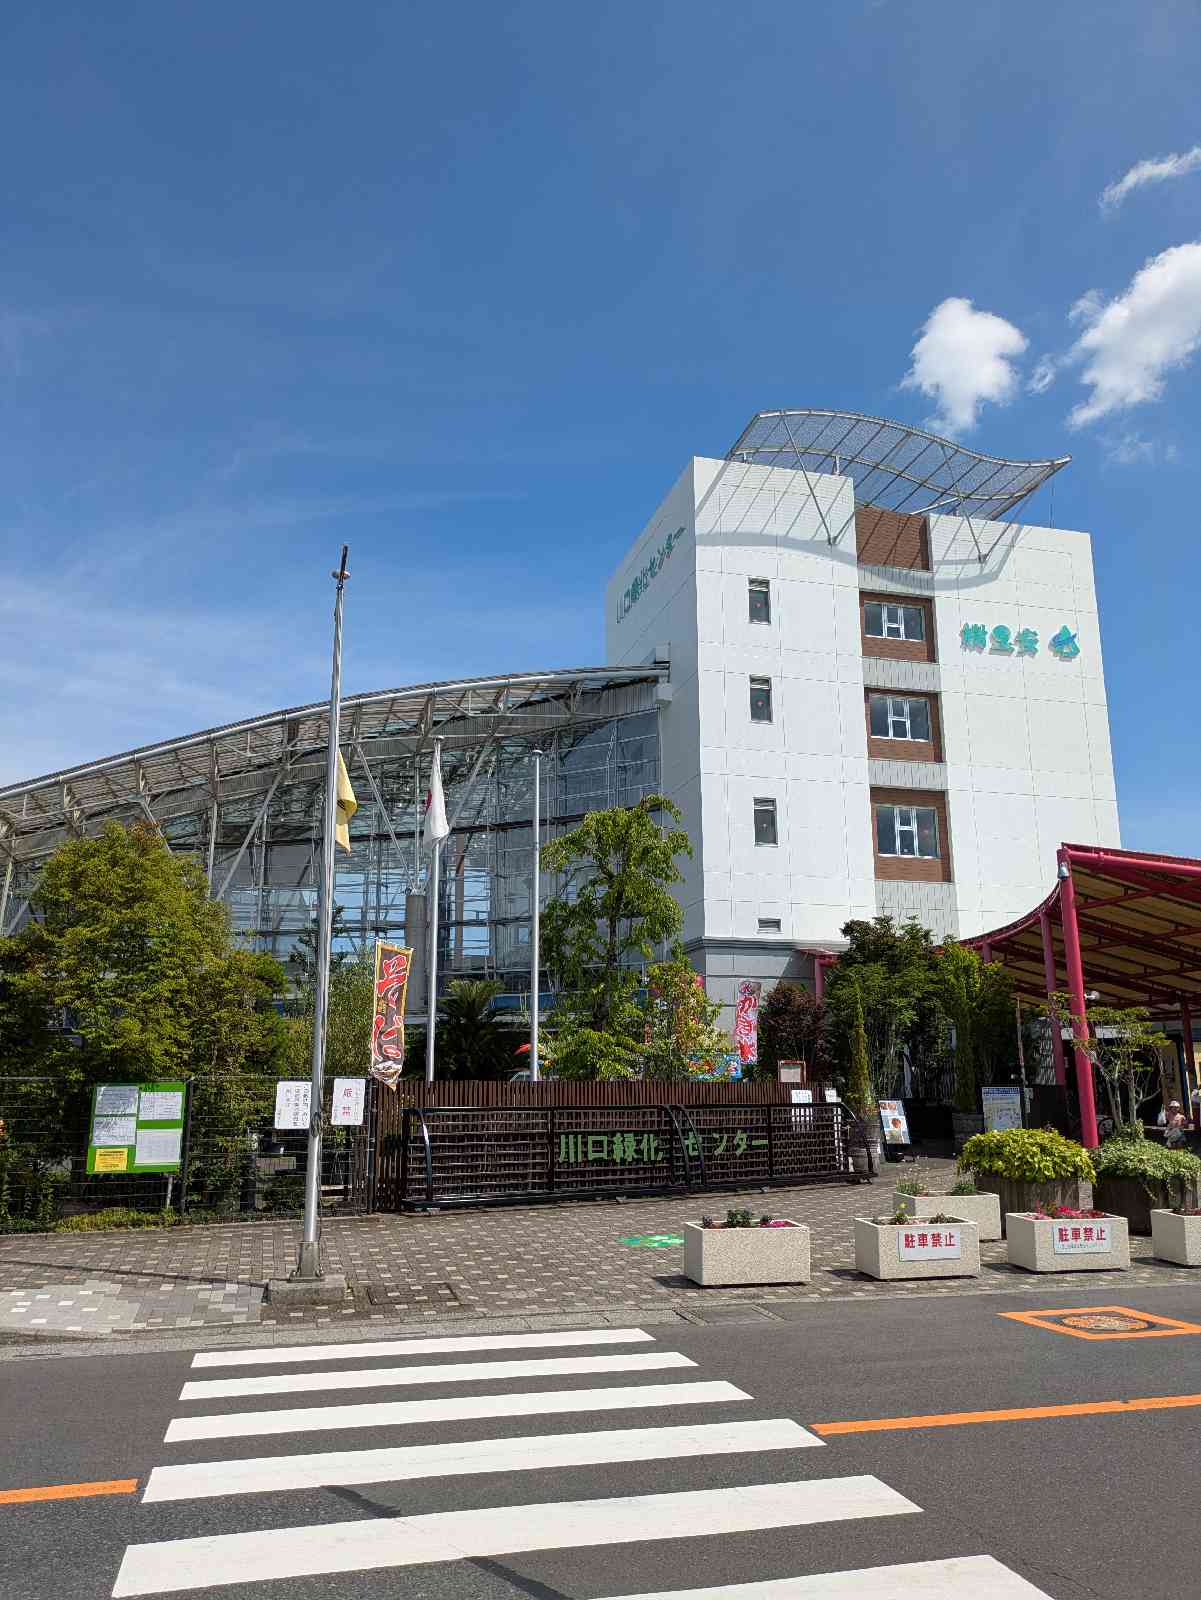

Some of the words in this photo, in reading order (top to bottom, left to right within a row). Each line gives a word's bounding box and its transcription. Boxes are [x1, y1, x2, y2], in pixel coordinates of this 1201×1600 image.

[903, 1231, 956, 1249] 駐車禁止
[1057, 1226, 1107, 1242] 駐車禁止
